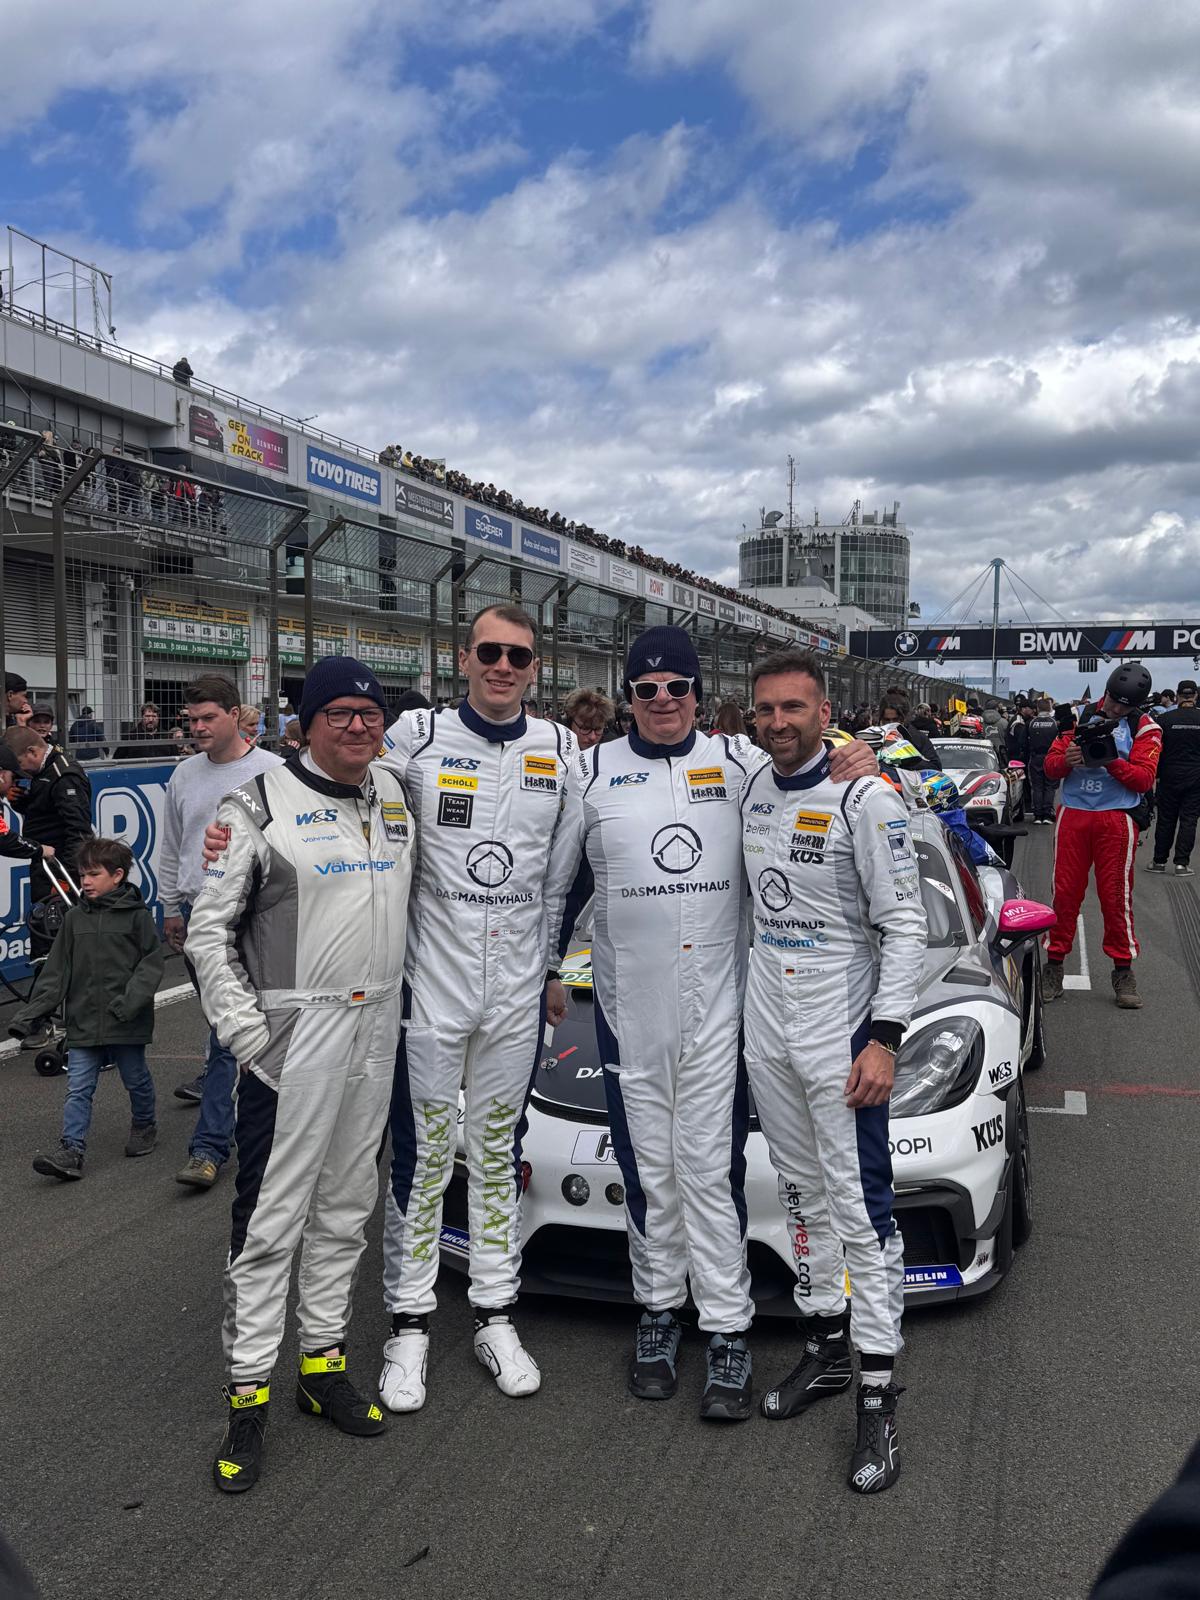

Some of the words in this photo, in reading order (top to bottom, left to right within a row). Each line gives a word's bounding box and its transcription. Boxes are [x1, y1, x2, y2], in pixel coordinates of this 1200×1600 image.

[228, 419, 247, 433] GET
[237, 434, 251, 446] ON
[231, 443, 263, 462] TRACK
[310, 455, 344, 485] TOYO
[344, 468, 379, 497] TIRES
[475, 518, 504, 538] SCHERER
[649, 578, 664, 597] ROWE
[1019, 632, 1082, 652] BMW
[441, 756, 481, 771] W&S
[441, 777, 475, 788] SCHÖLL
[608, 771, 650, 787] W&S
[447, 797, 466, 806] TEAM
[749, 802, 775, 815] W&S
[295, 808, 339, 826] W&S
[446, 807, 465, 815] WEAR
[789, 848, 825, 865] KÜS
[313, 860, 396, 876] Vöhringer
[1003, 906, 1027, 918] MVZ
[988, 1060, 1013, 1085] W&S
[971, 1113, 1004, 1153] KÜS
[326, 1358, 343, 1370] OMP
[237, 1393, 258, 1406] OMP
[767, 1391, 778, 1411] OMP
[863, 1399, 883, 1407] OMP
[218, 1462, 240, 1476] OMP
[855, 1464, 878, 1486] OMP
